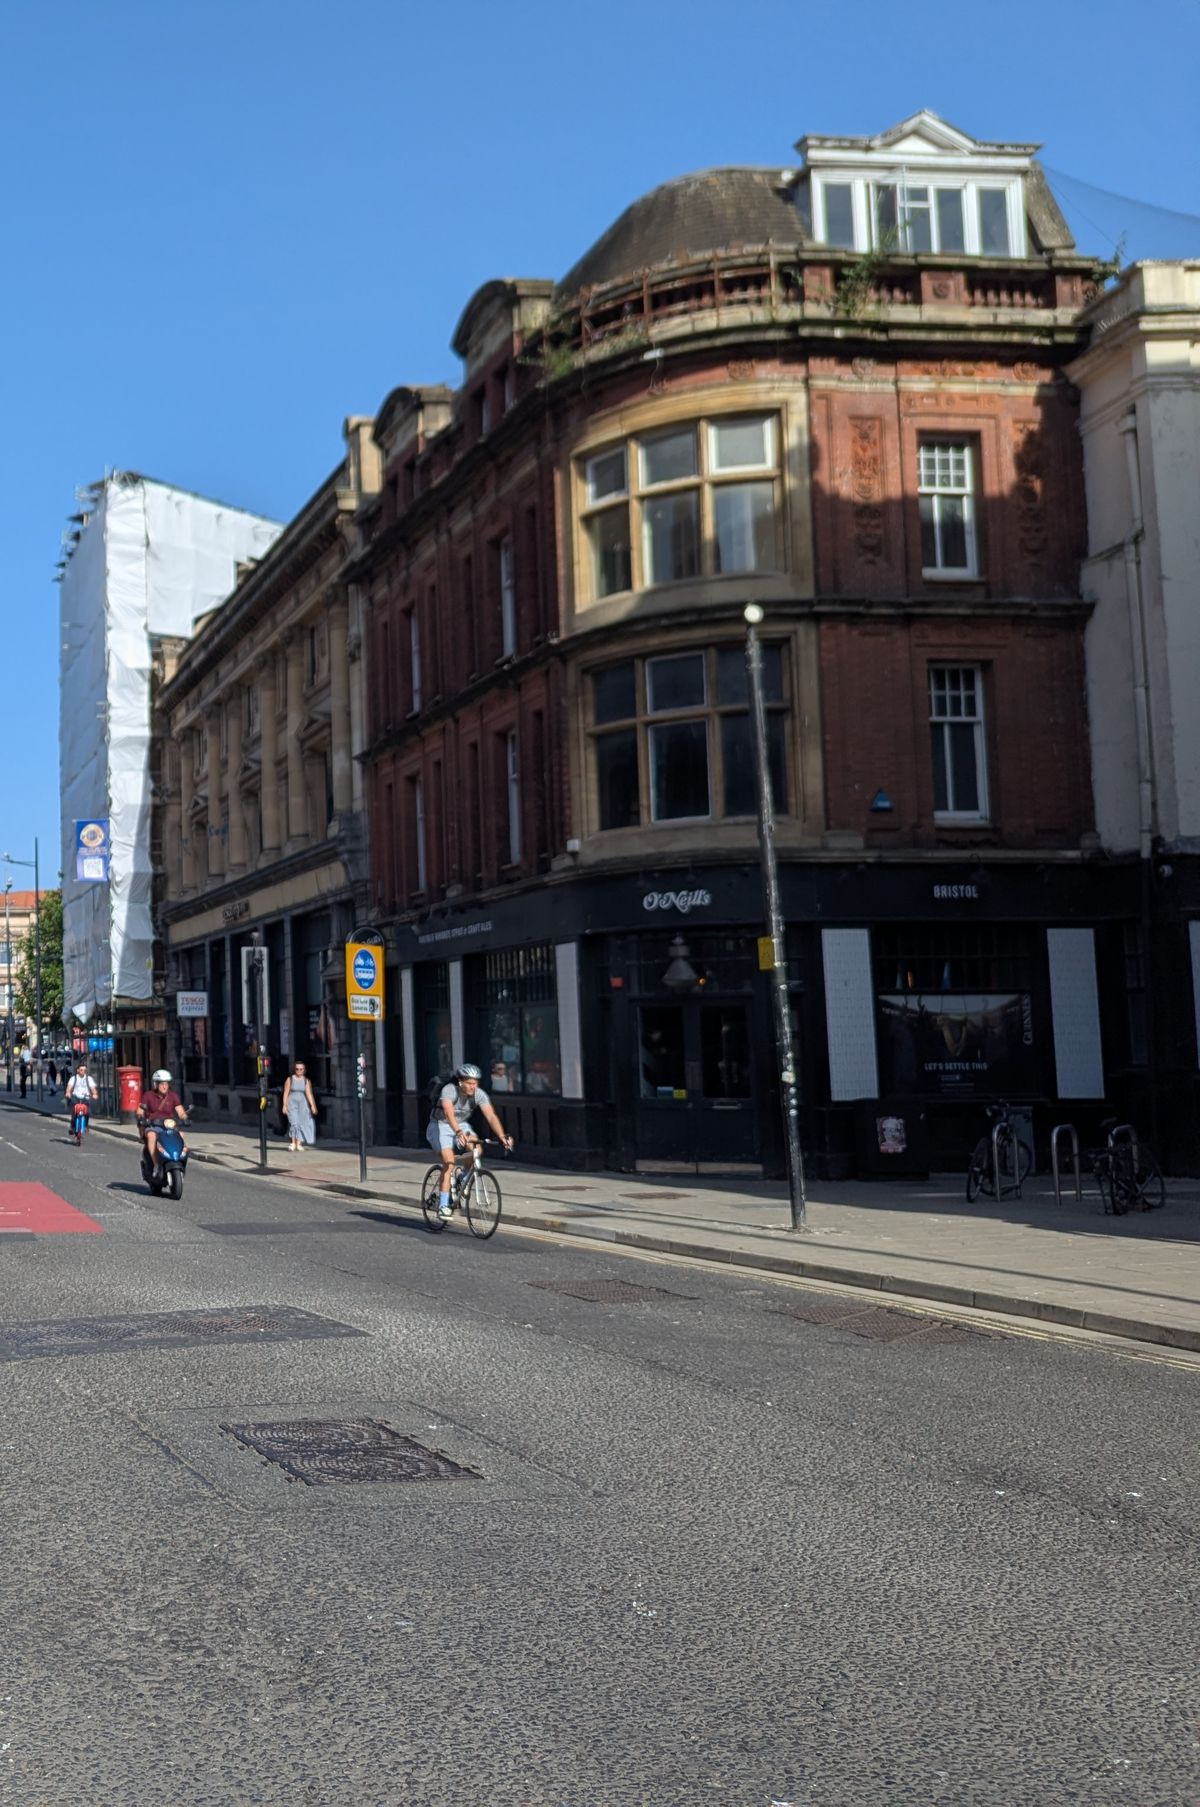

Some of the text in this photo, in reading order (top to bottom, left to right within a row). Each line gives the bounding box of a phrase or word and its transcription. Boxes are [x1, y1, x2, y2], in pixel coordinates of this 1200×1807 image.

[933, 884, 978, 899] BRISTOL
[642, 888, 713, 914] O'Neill's
[944, 1061, 970, 1071] SETTLE
[971, 1061, 988, 1071] THIS
